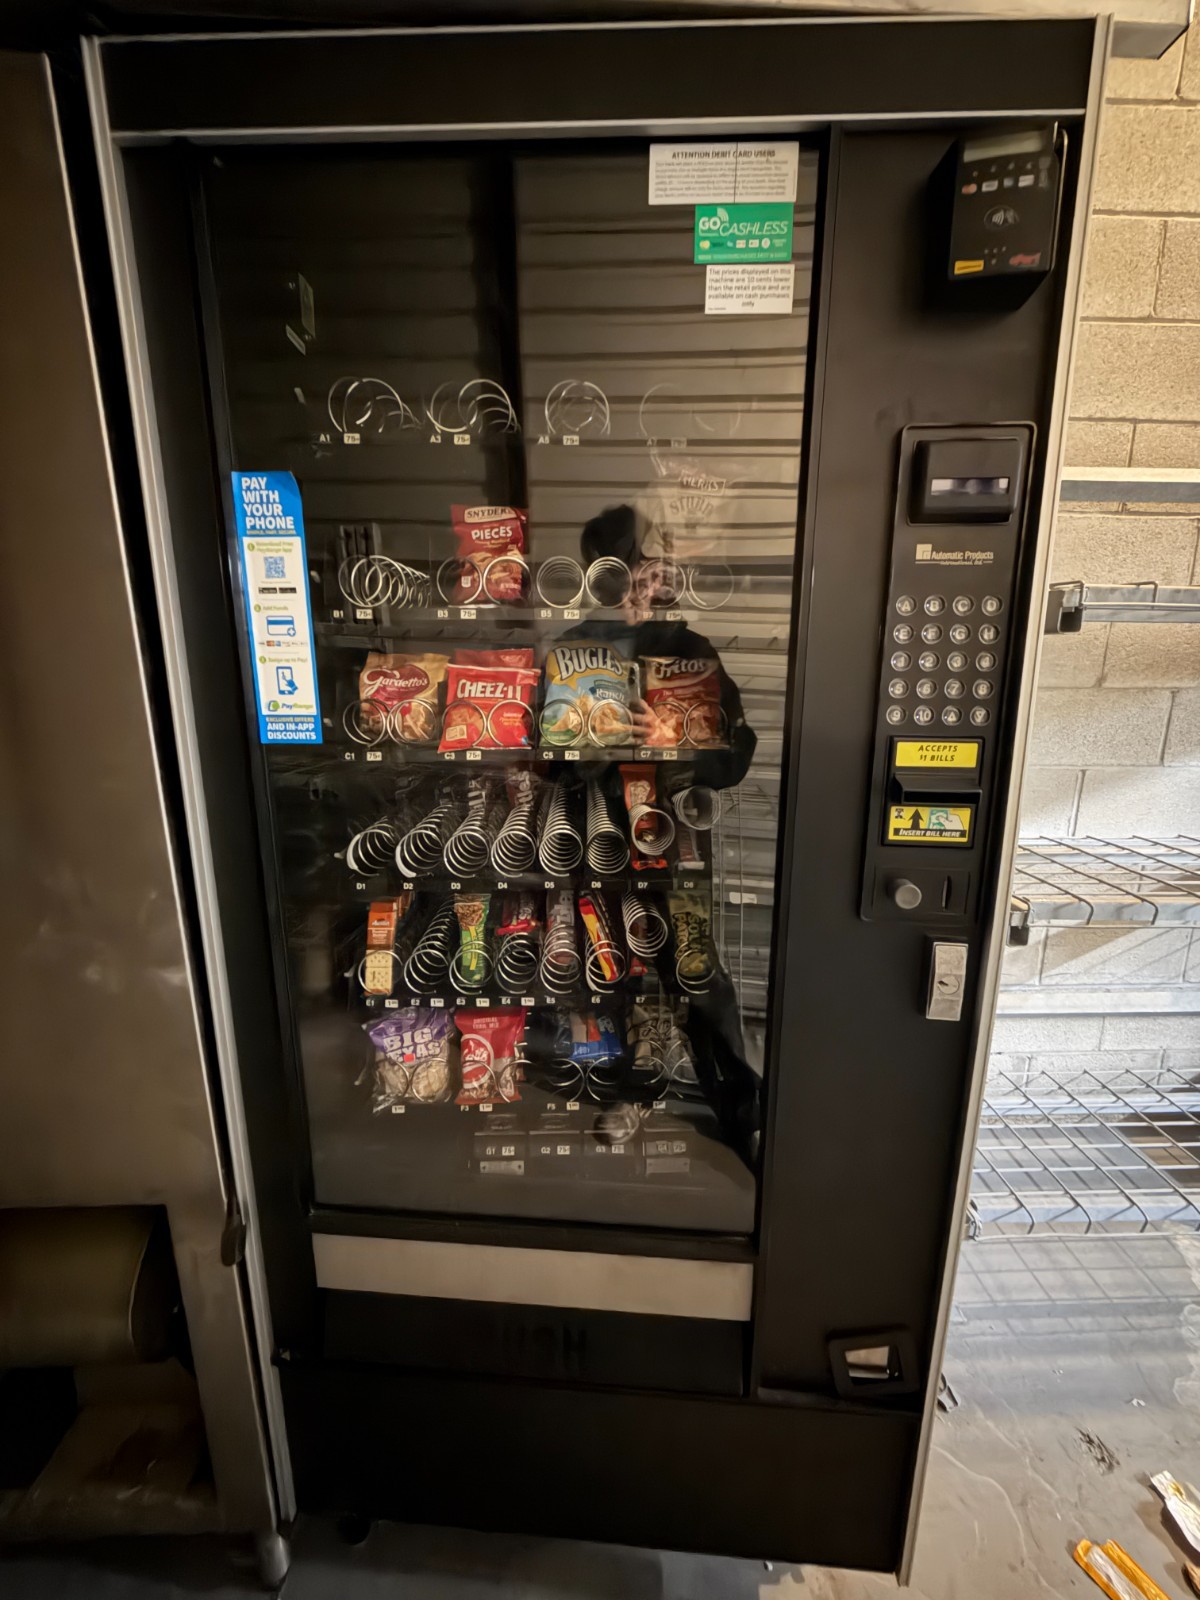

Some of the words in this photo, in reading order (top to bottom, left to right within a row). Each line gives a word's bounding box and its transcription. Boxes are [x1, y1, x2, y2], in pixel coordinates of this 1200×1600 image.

[672, 151, 710, 160] ATTENTION
[712, 150, 731, 158] DEBIT
[732, 150, 752, 158] CARD
[754, 150, 776, 158] USERS
[700, 216, 720, 230] GO
[720, 221, 789, 236] CASHLESS
[740, 268, 770, 276] displayed
[319, 434, 330, 442] A1
[430, 434, 441, 443] A3
[242, 477, 267, 490] PAY
[242, 490, 279, 503] WITH
[243, 504, 283, 516] YOUR
[467, 508, 512, 518] SNYDER
[246, 516, 295, 530] PHONE
[471, 526, 512, 540] PIECES
[932, 551, 963, 560] Automatic
[965, 551, 993, 560] Products
[902, 600, 910, 612] A
[930, 600, 939, 612] B
[958, 600, 968, 612] C
[986, 600, 996, 612] D
[438, 610, 448, 618] B3
[900, 628, 909, 639] E
[928, 628, 936, 639] F
[955, 628, 966, 640] G
[984, 628, 994, 640] H
[555, 647, 622, 680] BUGLES
[925, 656, 934, 667] 2
[952, 656, 962, 667] 3
[364, 666, 428, 697] Gardetto's
[596, 688, 624, 701] Ranch
[895, 684, 903, 694] 5
[922, 684, 931, 694] 6
[950, 684, 959, 695] 7
[979, 684, 988, 695] 8
[892, 710, 900, 721] 9
[920, 711, 932, 722] 10
[286, 722, 315, 731] IN-APP
[267, 731, 316, 740] DISCOUNTS
[383, 1027, 433, 1049] BIG
